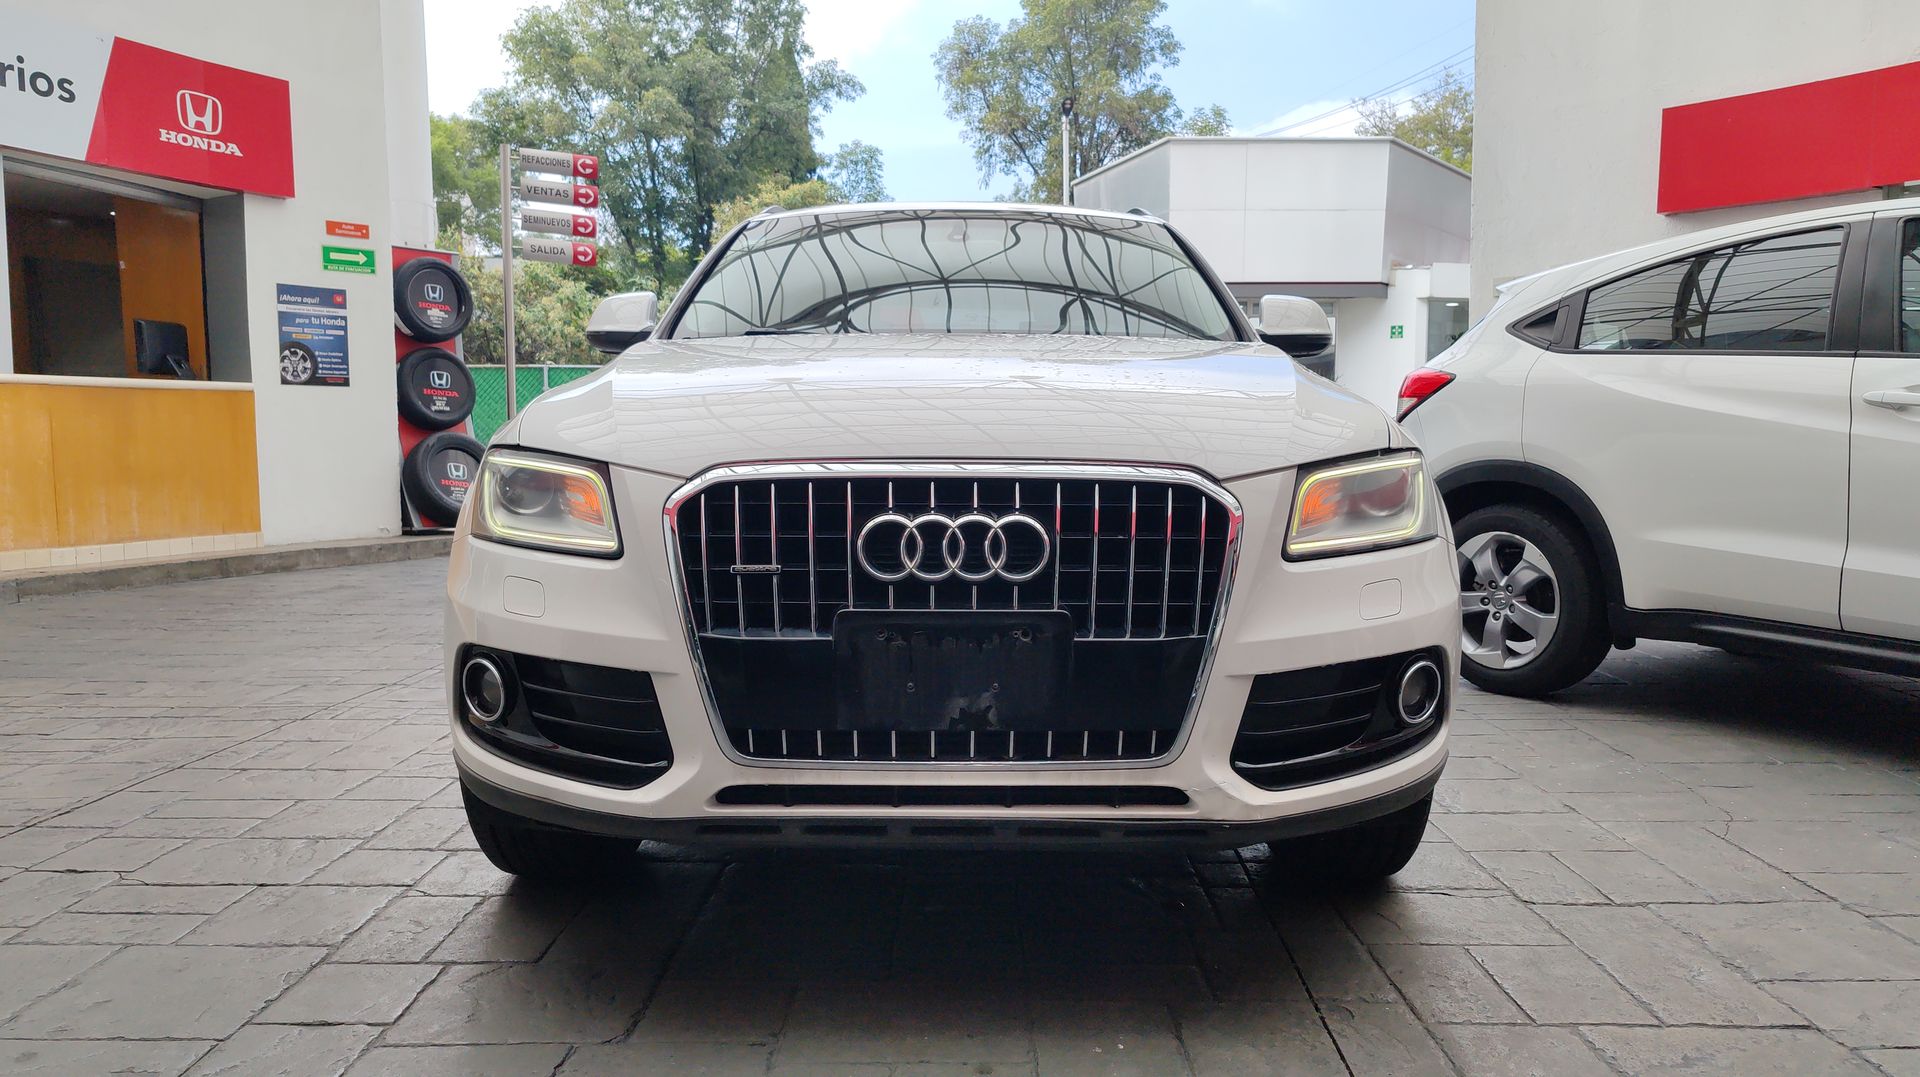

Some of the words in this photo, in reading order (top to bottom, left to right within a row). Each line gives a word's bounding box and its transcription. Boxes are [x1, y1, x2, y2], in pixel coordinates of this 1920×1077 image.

[0, 55, 76, 103] rios
[159, 129, 243, 157] HONDA
[522, 154, 571, 169] REFACCIONES
[526, 185, 569, 199] VENTAS
[523, 214, 571, 228] SEMINUEVOS
[530, 244, 566, 256] SALIDA
[417, 301, 452, 312] HONDA
[311, 316, 320, 324] tu
[321, 317, 346, 326] Honda
[423, 388, 460, 398] HONDA
[441, 479, 470, 488] HOND
